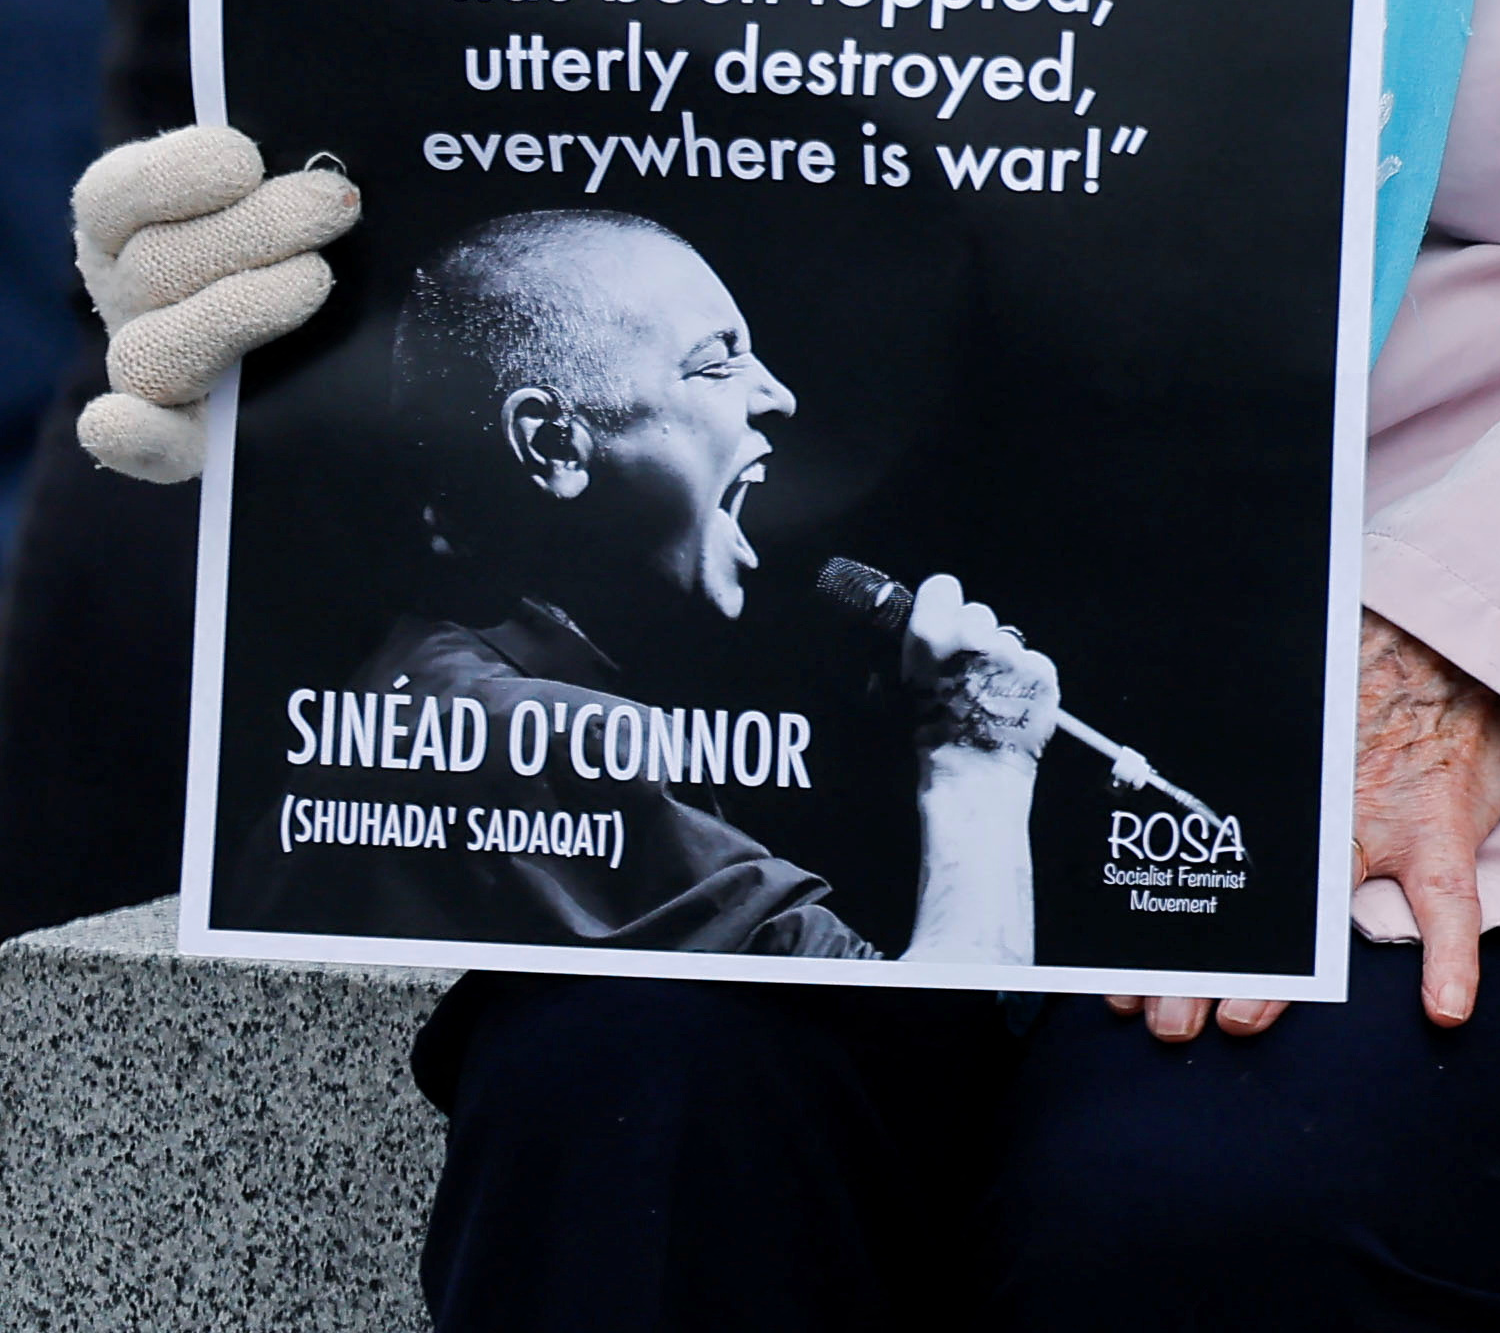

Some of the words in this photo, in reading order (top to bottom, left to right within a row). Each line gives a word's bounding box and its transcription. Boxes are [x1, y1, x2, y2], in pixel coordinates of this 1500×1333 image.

[465, 20, 689, 112] utterly
[714, 22, 1097, 120] destroyed,
[423, 111, 836, 194] everywhere
[861, 122, 911, 188] is
[287, 674, 488, 774] SINÉAD
[509, 699, 812, 789] O'CONNOR
[280, 794, 457, 853] (SHUHADA'
[467, 807, 625, 870] SADAQAT)
[1107, 810, 1246, 864] ROSA
[1103, 863, 1174, 887] Socialist
[1178, 866, 1247, 889] Feminist
[1130, 889, 1218, 914] Movement
